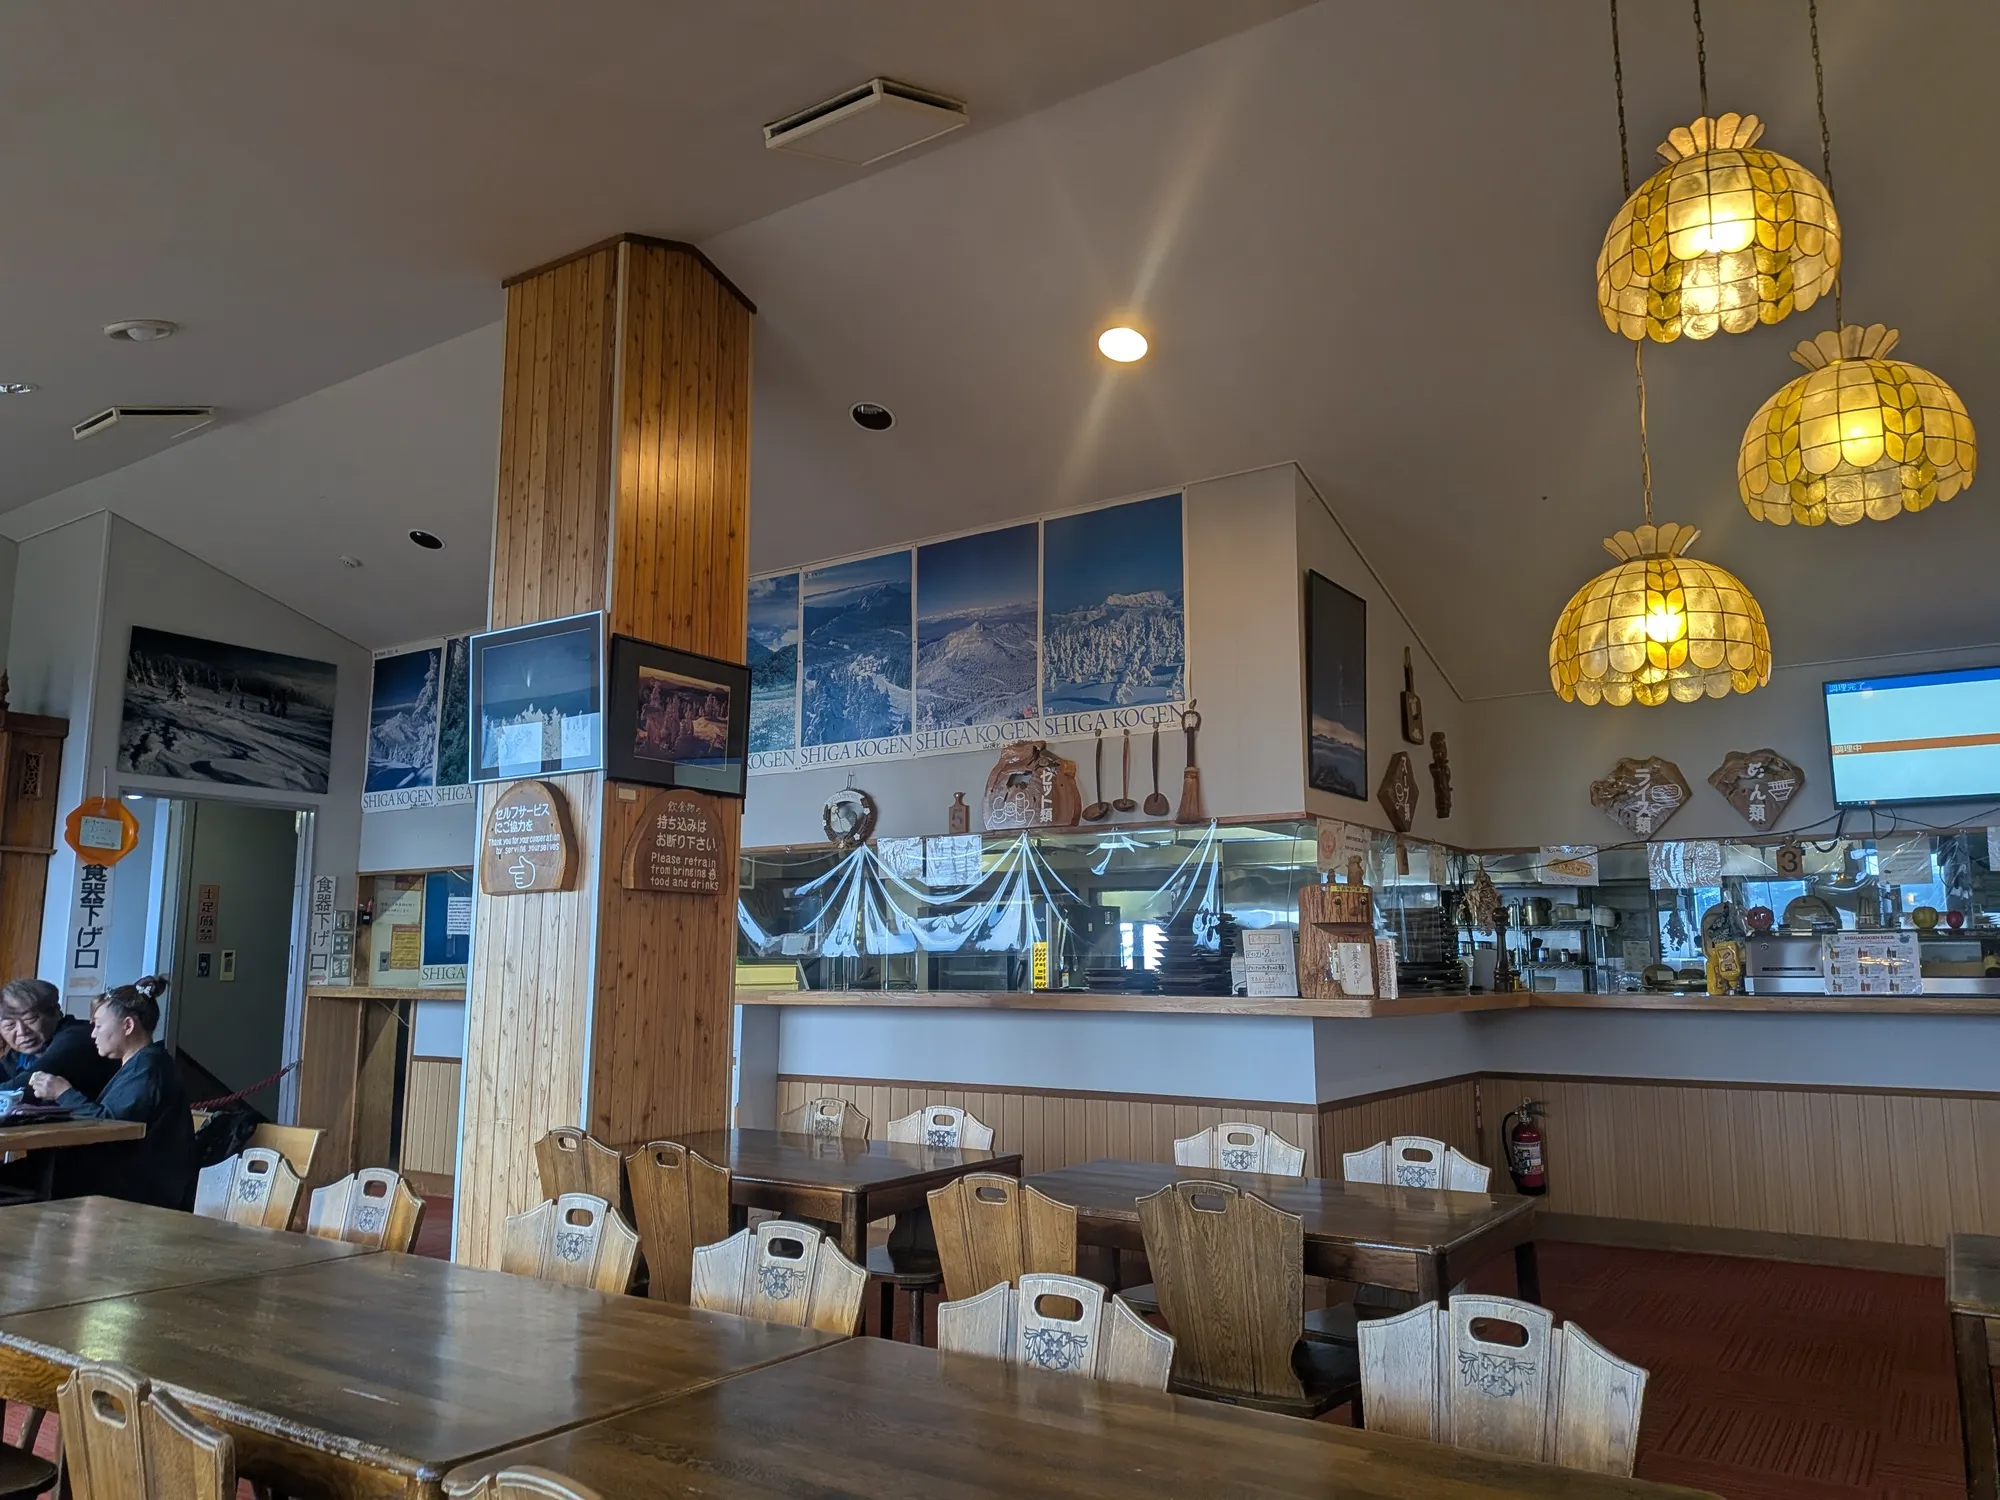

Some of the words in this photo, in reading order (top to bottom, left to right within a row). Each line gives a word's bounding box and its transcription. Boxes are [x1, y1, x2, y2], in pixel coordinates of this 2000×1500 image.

[1829, 682, 1865, 693] 調理完了
[1045, 713, 1107, 736] SHIGA
[1112, 704, 1185, 728] KOGEN
[916, 729, 971, 751] SHIGA
[974, 720, 1040, 743] KOGEN
[801, 743, 851, 765] SHIGA
[854, 736, 912, 758] KOGEN
[1834, 744, 1862, 754] 調理中
[363, 793, 396, 809] SHIGA
[396, 788, 433, 804] KOGEN
[436, 786, 473, 802] SHIGA
[1040, 768, 1056, 823] セット類
[1635, 768, 1652, 833] ライス類
[1747, 762, 1766, 822] めん類
[495, 803, 550, 820] セルフサービス
[668, 801, 701, 815] 飲食物の
[494, 819, 533, 834] にご協力を
[656, 814, 707, 833] 持ち込みは
[488, 838, 502, 847] Thank
[503, 837, 511, 846] you
[519, 836, 529, 844] your
[530, 833, 560, 843] cooperation
[496, 847, 502, 855] by
[505, 845, 526, 855] serving
[528, 843, 560, 852] yourselves
[651, 852, 681, 864] Please
[684, 857, 717, 868] refrain
[1780, 851, 1798, 873] 3
[650, 864, 671, 875] from
[673, 866, 706, 878] bringing
[650, 876, 670, 887] food
[672, 878, 688, 888] and
[691, 878, 719, 890] drinks
[74, 863, 107, 969] 食器下げ口
[310, 876, 333, 971] 食器下げ口
[421, 966, 466, 981] SHIGA
